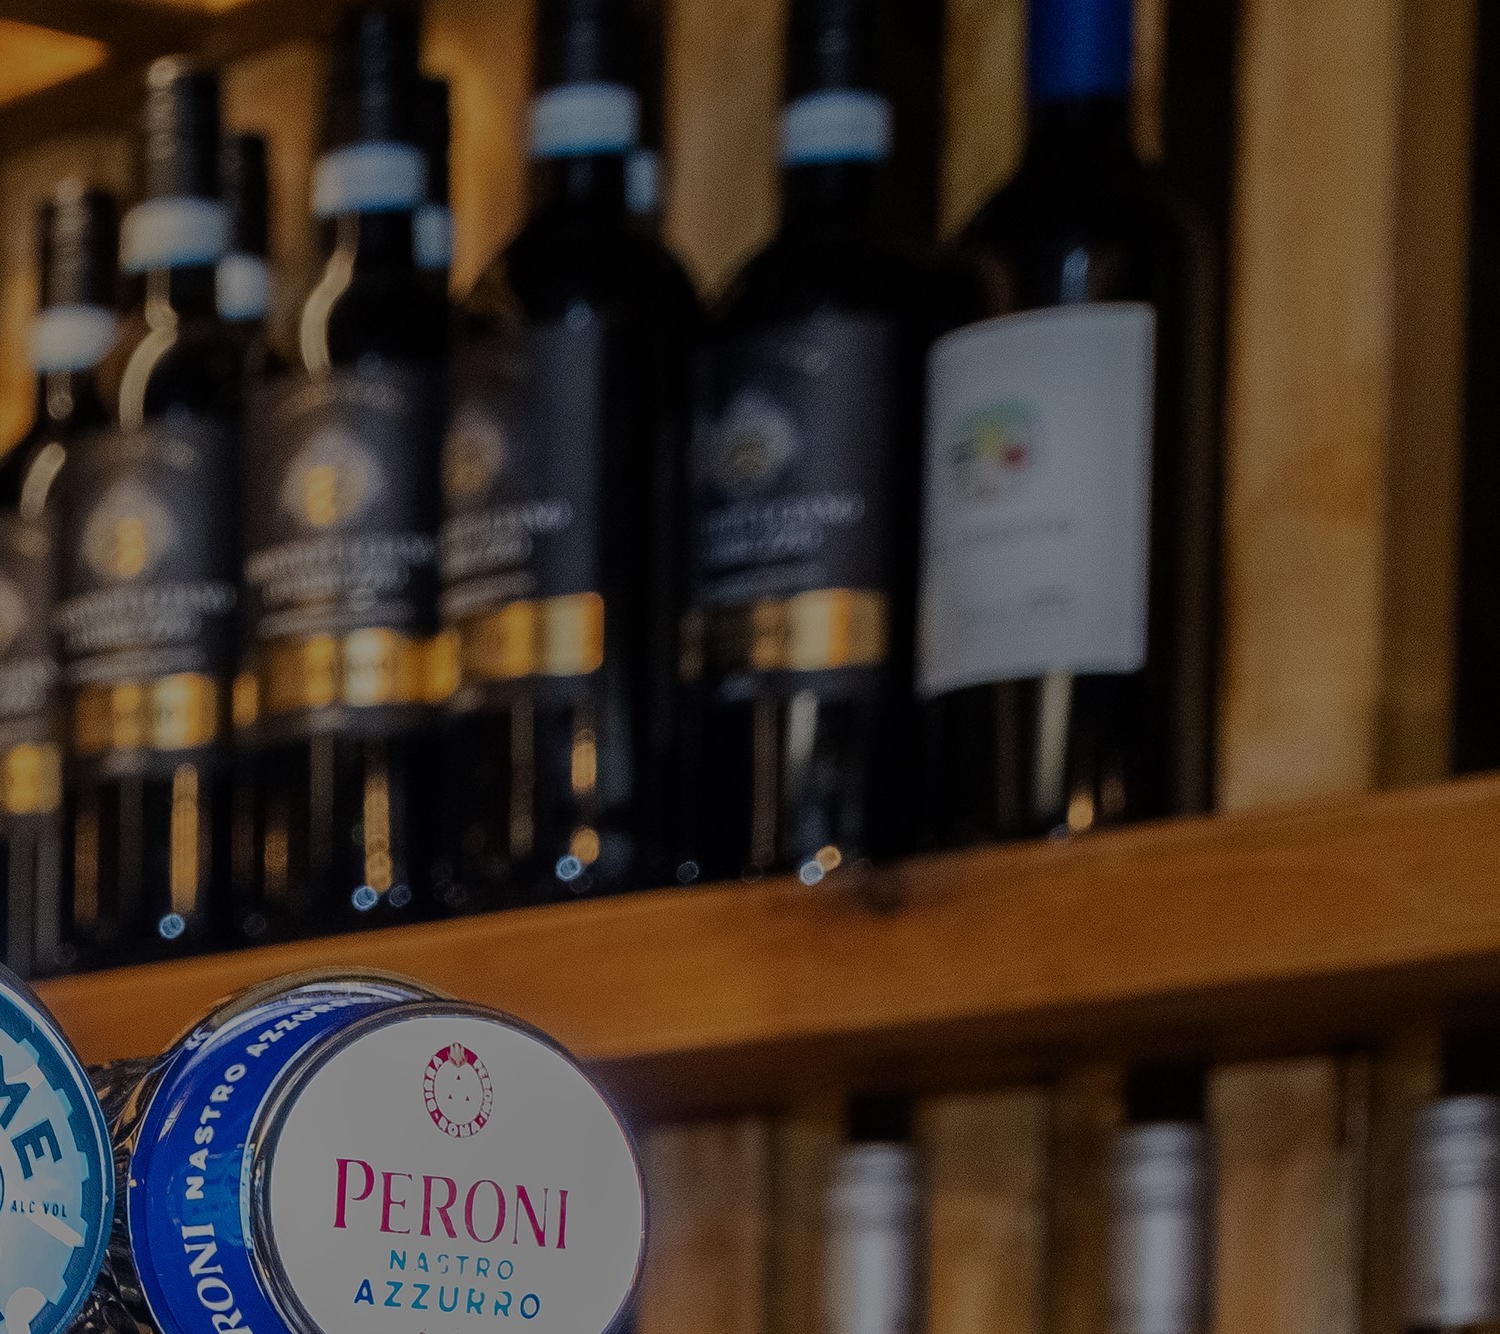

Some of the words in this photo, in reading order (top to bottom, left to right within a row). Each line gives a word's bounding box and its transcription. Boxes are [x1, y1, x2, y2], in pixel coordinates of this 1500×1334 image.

[184, 1061, 248, 1202] NASTRO
[10, 1199, 36, 1214] ALC
[42, 1202, 68, 1219] VOL
[333, 1157, 570, 1250] PERONI
[388, 1249, 516, 1281] NASTRO
[353, 1279, 541, 1320] AZZURRO
